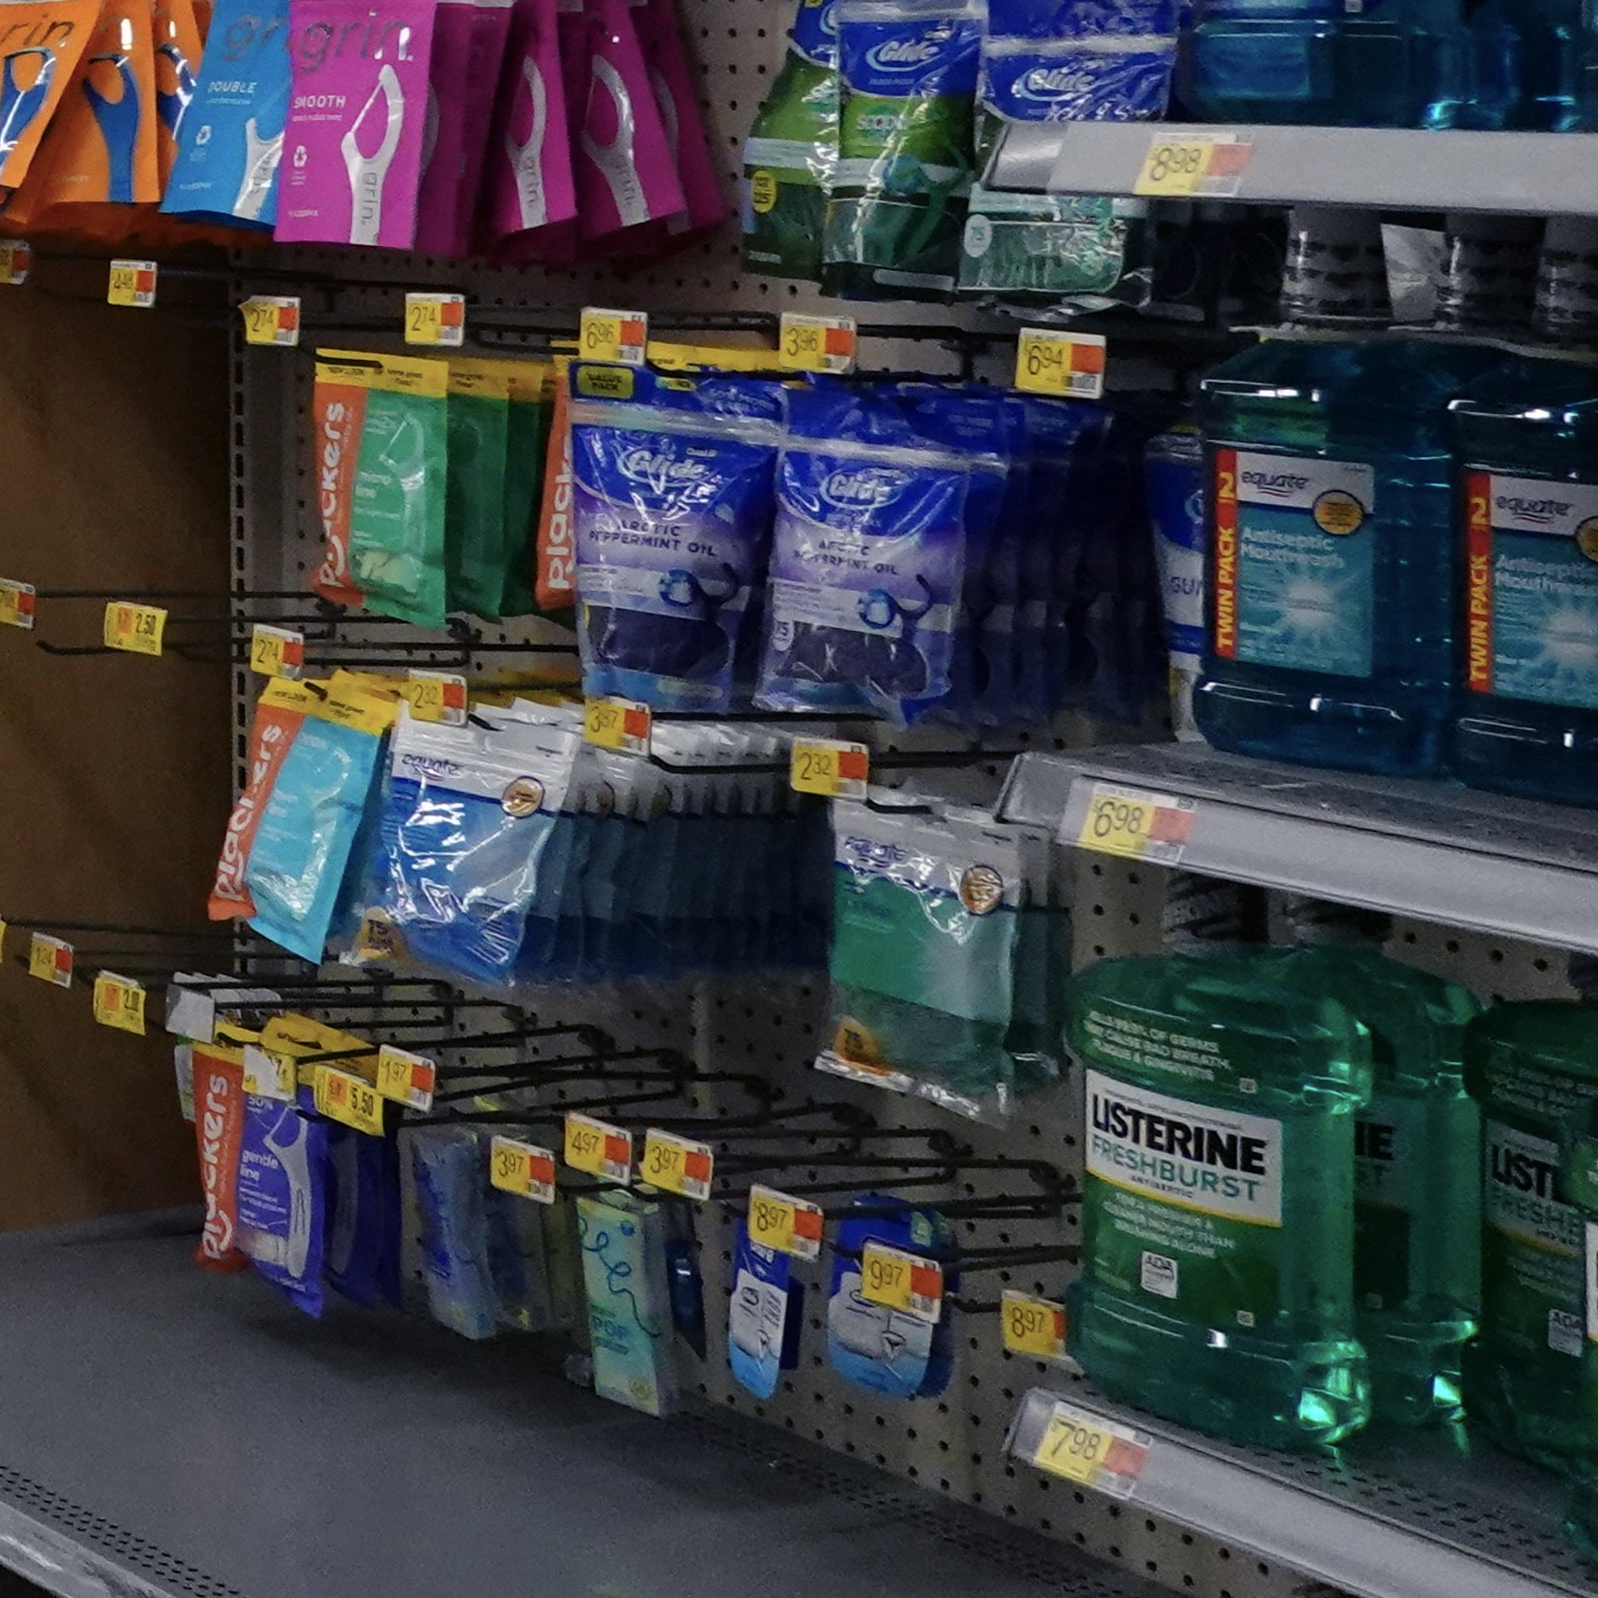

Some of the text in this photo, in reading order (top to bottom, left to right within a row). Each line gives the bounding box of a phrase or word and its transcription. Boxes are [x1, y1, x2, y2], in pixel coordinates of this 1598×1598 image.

[208, 81, 258, 94] DOUBLE
[294, 95, 346, 109] SMOOTH
[1241, 470, 1309, 491] equate
[1495, 494, 1573, 517] equate
[589, 530, 717, 557] PEPPERMINT OIL
[1217, 527, 1235, 649] TWIN PACK
[1469, 555, 1489, 682] TWIN PACK
[1092, 1092, 1267, 1177] LISTERINE
[242, 1148, 279, 1170] gentle
[1091, 1133, 1261, 1203] FRESHBURST
